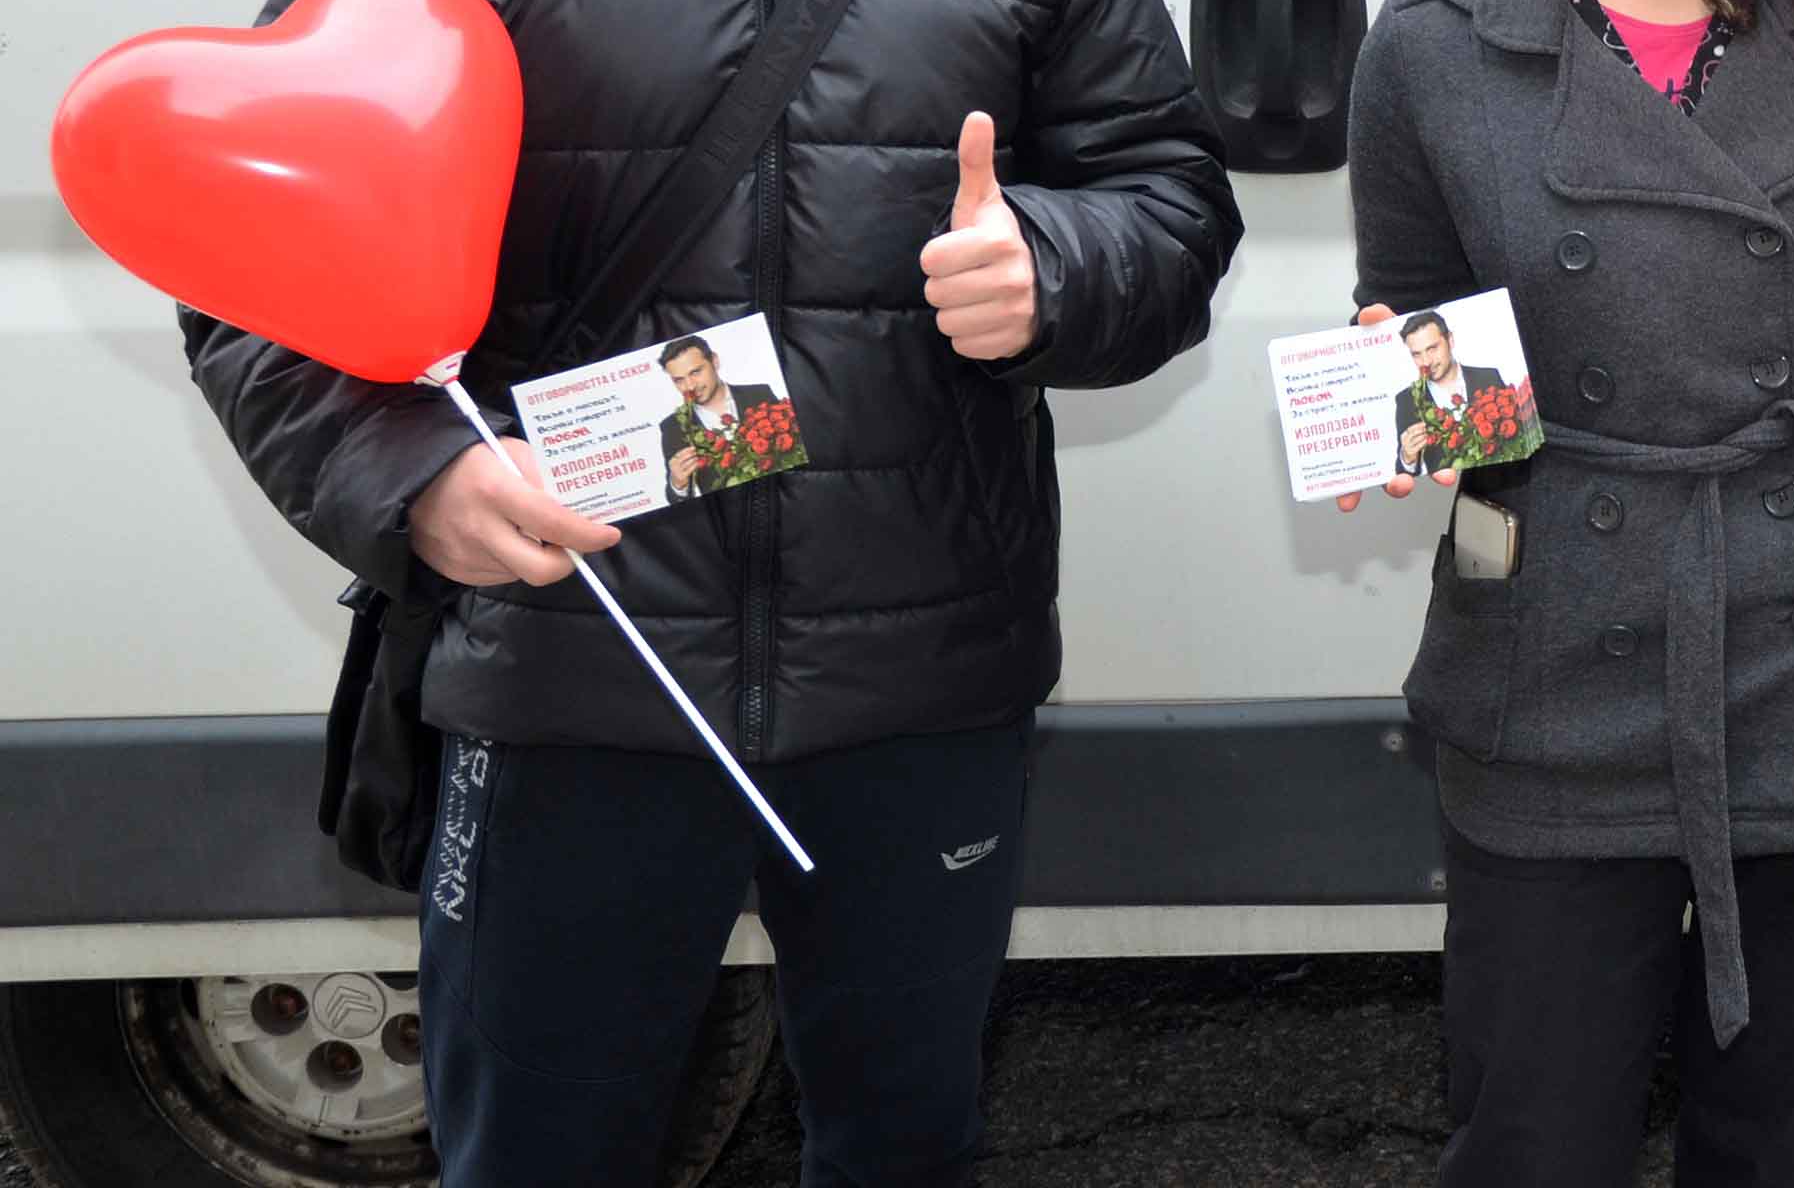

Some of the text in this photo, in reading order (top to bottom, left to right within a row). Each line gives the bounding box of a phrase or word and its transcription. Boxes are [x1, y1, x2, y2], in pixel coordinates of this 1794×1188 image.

[1363, 334, 1393, 347] СЕКСИ
[527, 375, 609, 405] ОТГОВОРНОСТТА
[620, 363, 651, 379] СЕКСИ
[1294, 414, 1366, 440] ИЗПОЛЗВАЙ
[545, 448, 559, 457] За
[1298, 428, 1381, 457] ПРЕЗЕРВАТИВ
[551, 444, 630, 477] ИЗПОЛЗВАЙ
[556, 459, 647, 493] ПРЕЗЕРВАТИВ
